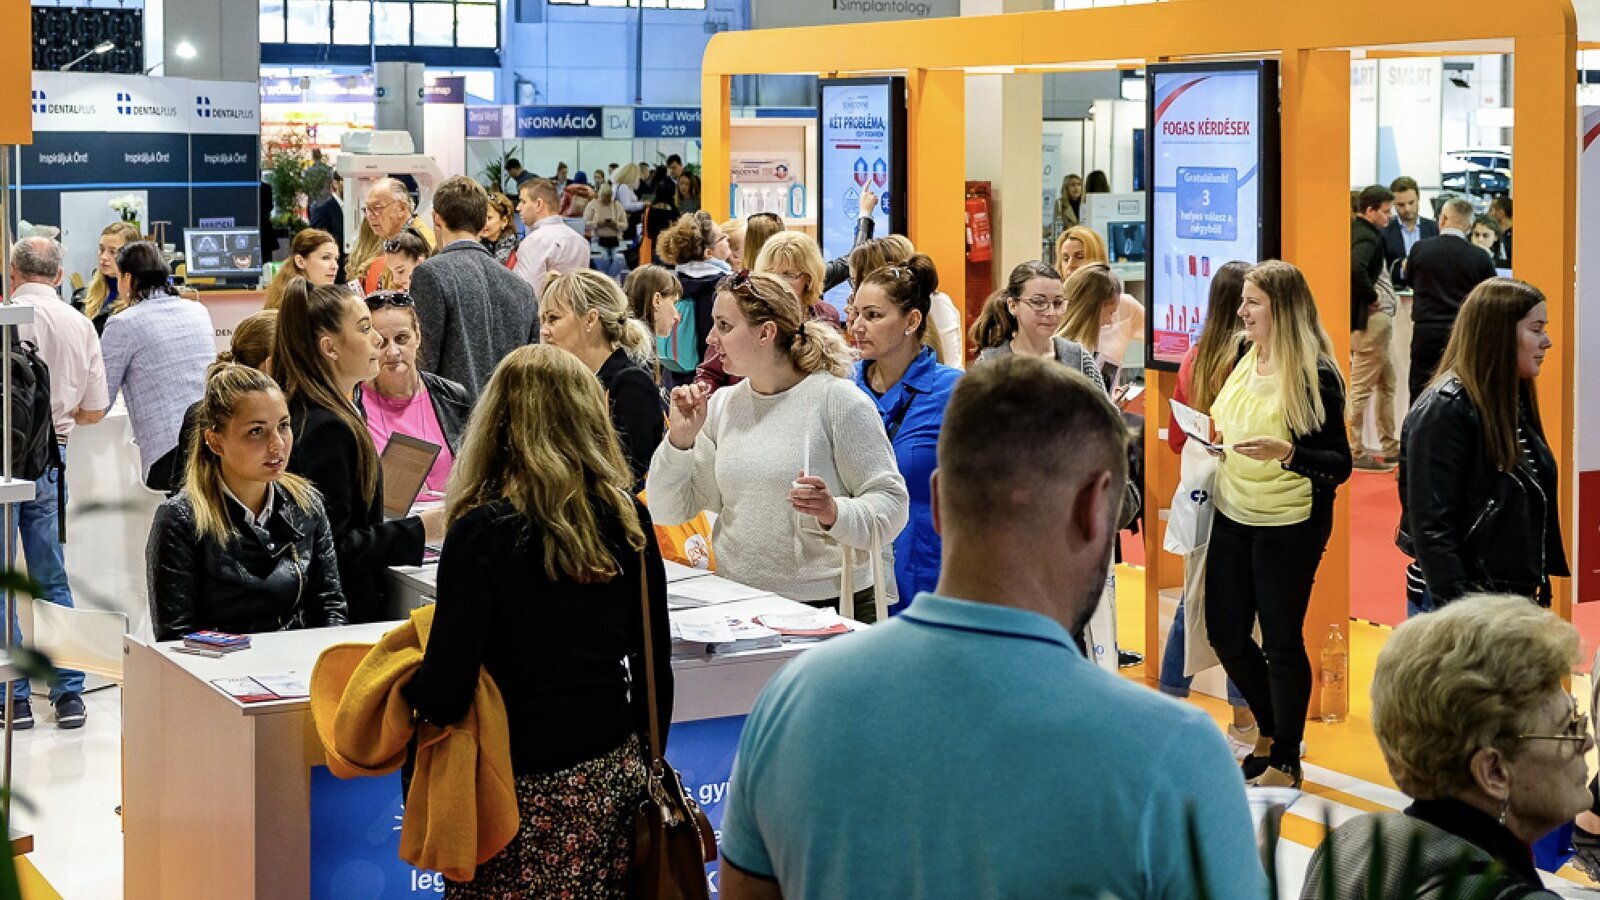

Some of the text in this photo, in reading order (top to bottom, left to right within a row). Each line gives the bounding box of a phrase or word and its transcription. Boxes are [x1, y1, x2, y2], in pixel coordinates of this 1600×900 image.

[48, 103, 95, 114] DENTALPLUS
[133, 106, 177, 116] DENTALPLUS
[212, 108, 254, 119] DENTALPLUS
[642, 111, 675, 121] Dental
[661, 125, 686, 135] 2019
[1163, 117, 1250, 135] FOGAS KÉRDÉSEK
[1202, 189, 1210, 206] 3
